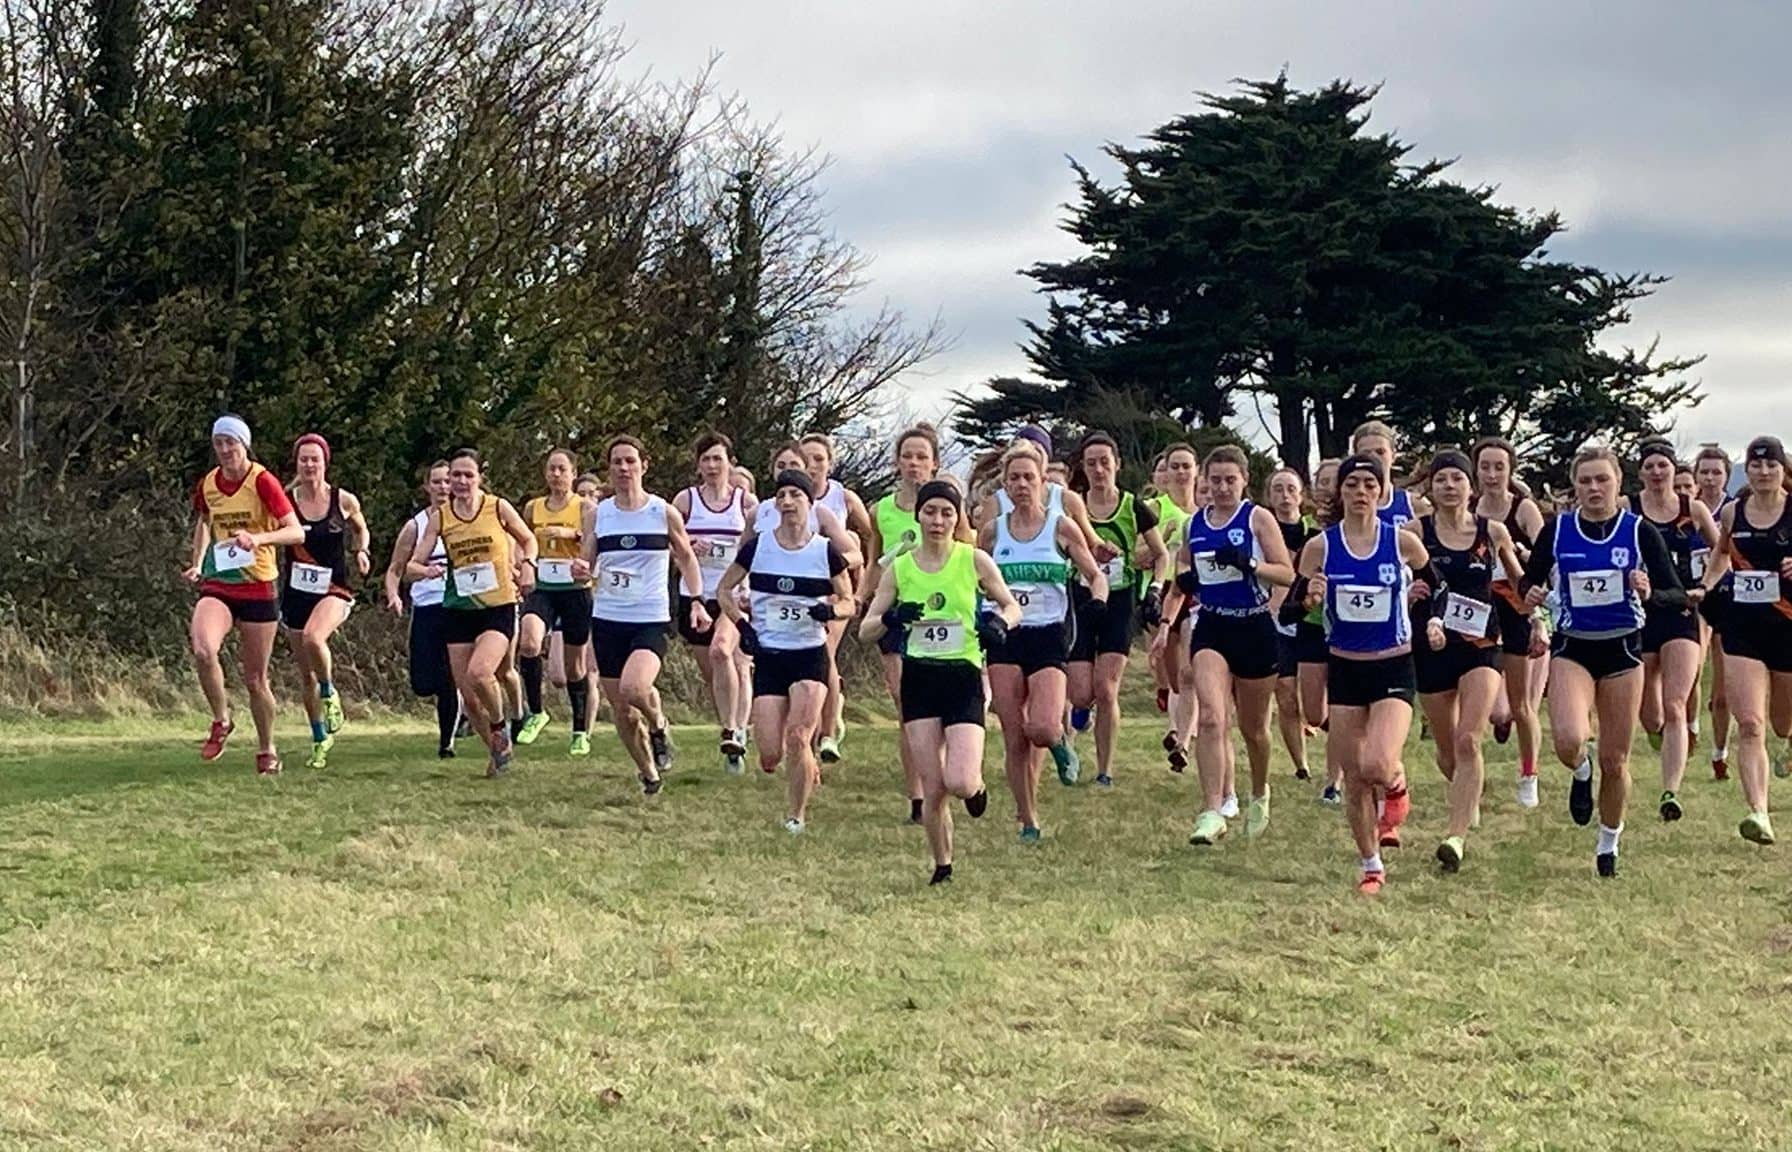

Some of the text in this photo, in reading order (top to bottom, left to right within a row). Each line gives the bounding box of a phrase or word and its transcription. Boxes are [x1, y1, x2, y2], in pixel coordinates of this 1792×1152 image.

[228, 545, 237, 558] 6
[301, 569, 318, 584] 18
[469, 572, 478, 584] 7
[611, 573, 630, 588] 33
[1744, 576, 1764, 591] 20
[1583, 578, 1608, 593] 42
[1350, 594, 1375, 609] 45
[779, 607, 801, 621] 35
[1451, 605, 1474, 621] 19
[924, 627, 948, 642] 49
